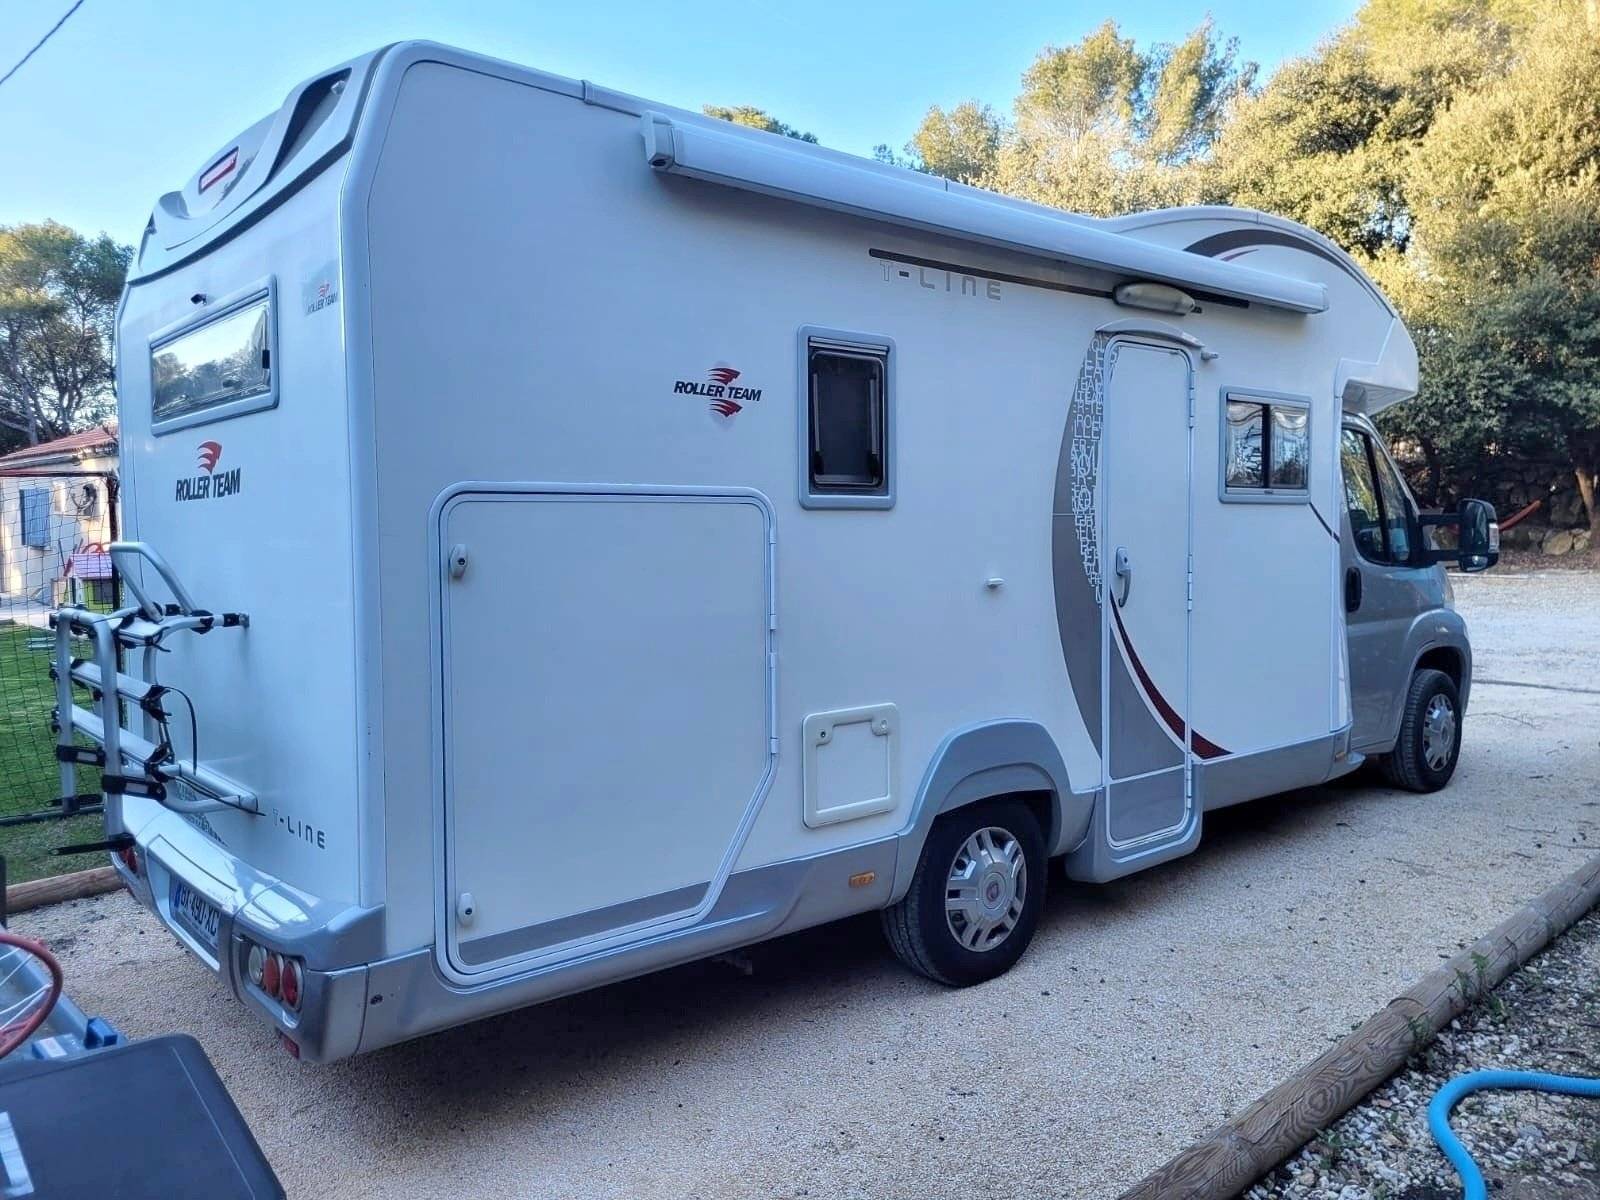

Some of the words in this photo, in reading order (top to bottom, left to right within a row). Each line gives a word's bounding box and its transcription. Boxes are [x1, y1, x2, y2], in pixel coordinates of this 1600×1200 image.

[880, 260, 1001, 301] T-LINE
[674, 380, 725, 398] ROLLER
[728, 386, 762, 402] TEAM
[175, 475, 211, 502] ROLLER
[212, 467, 241, 498] TEAM
